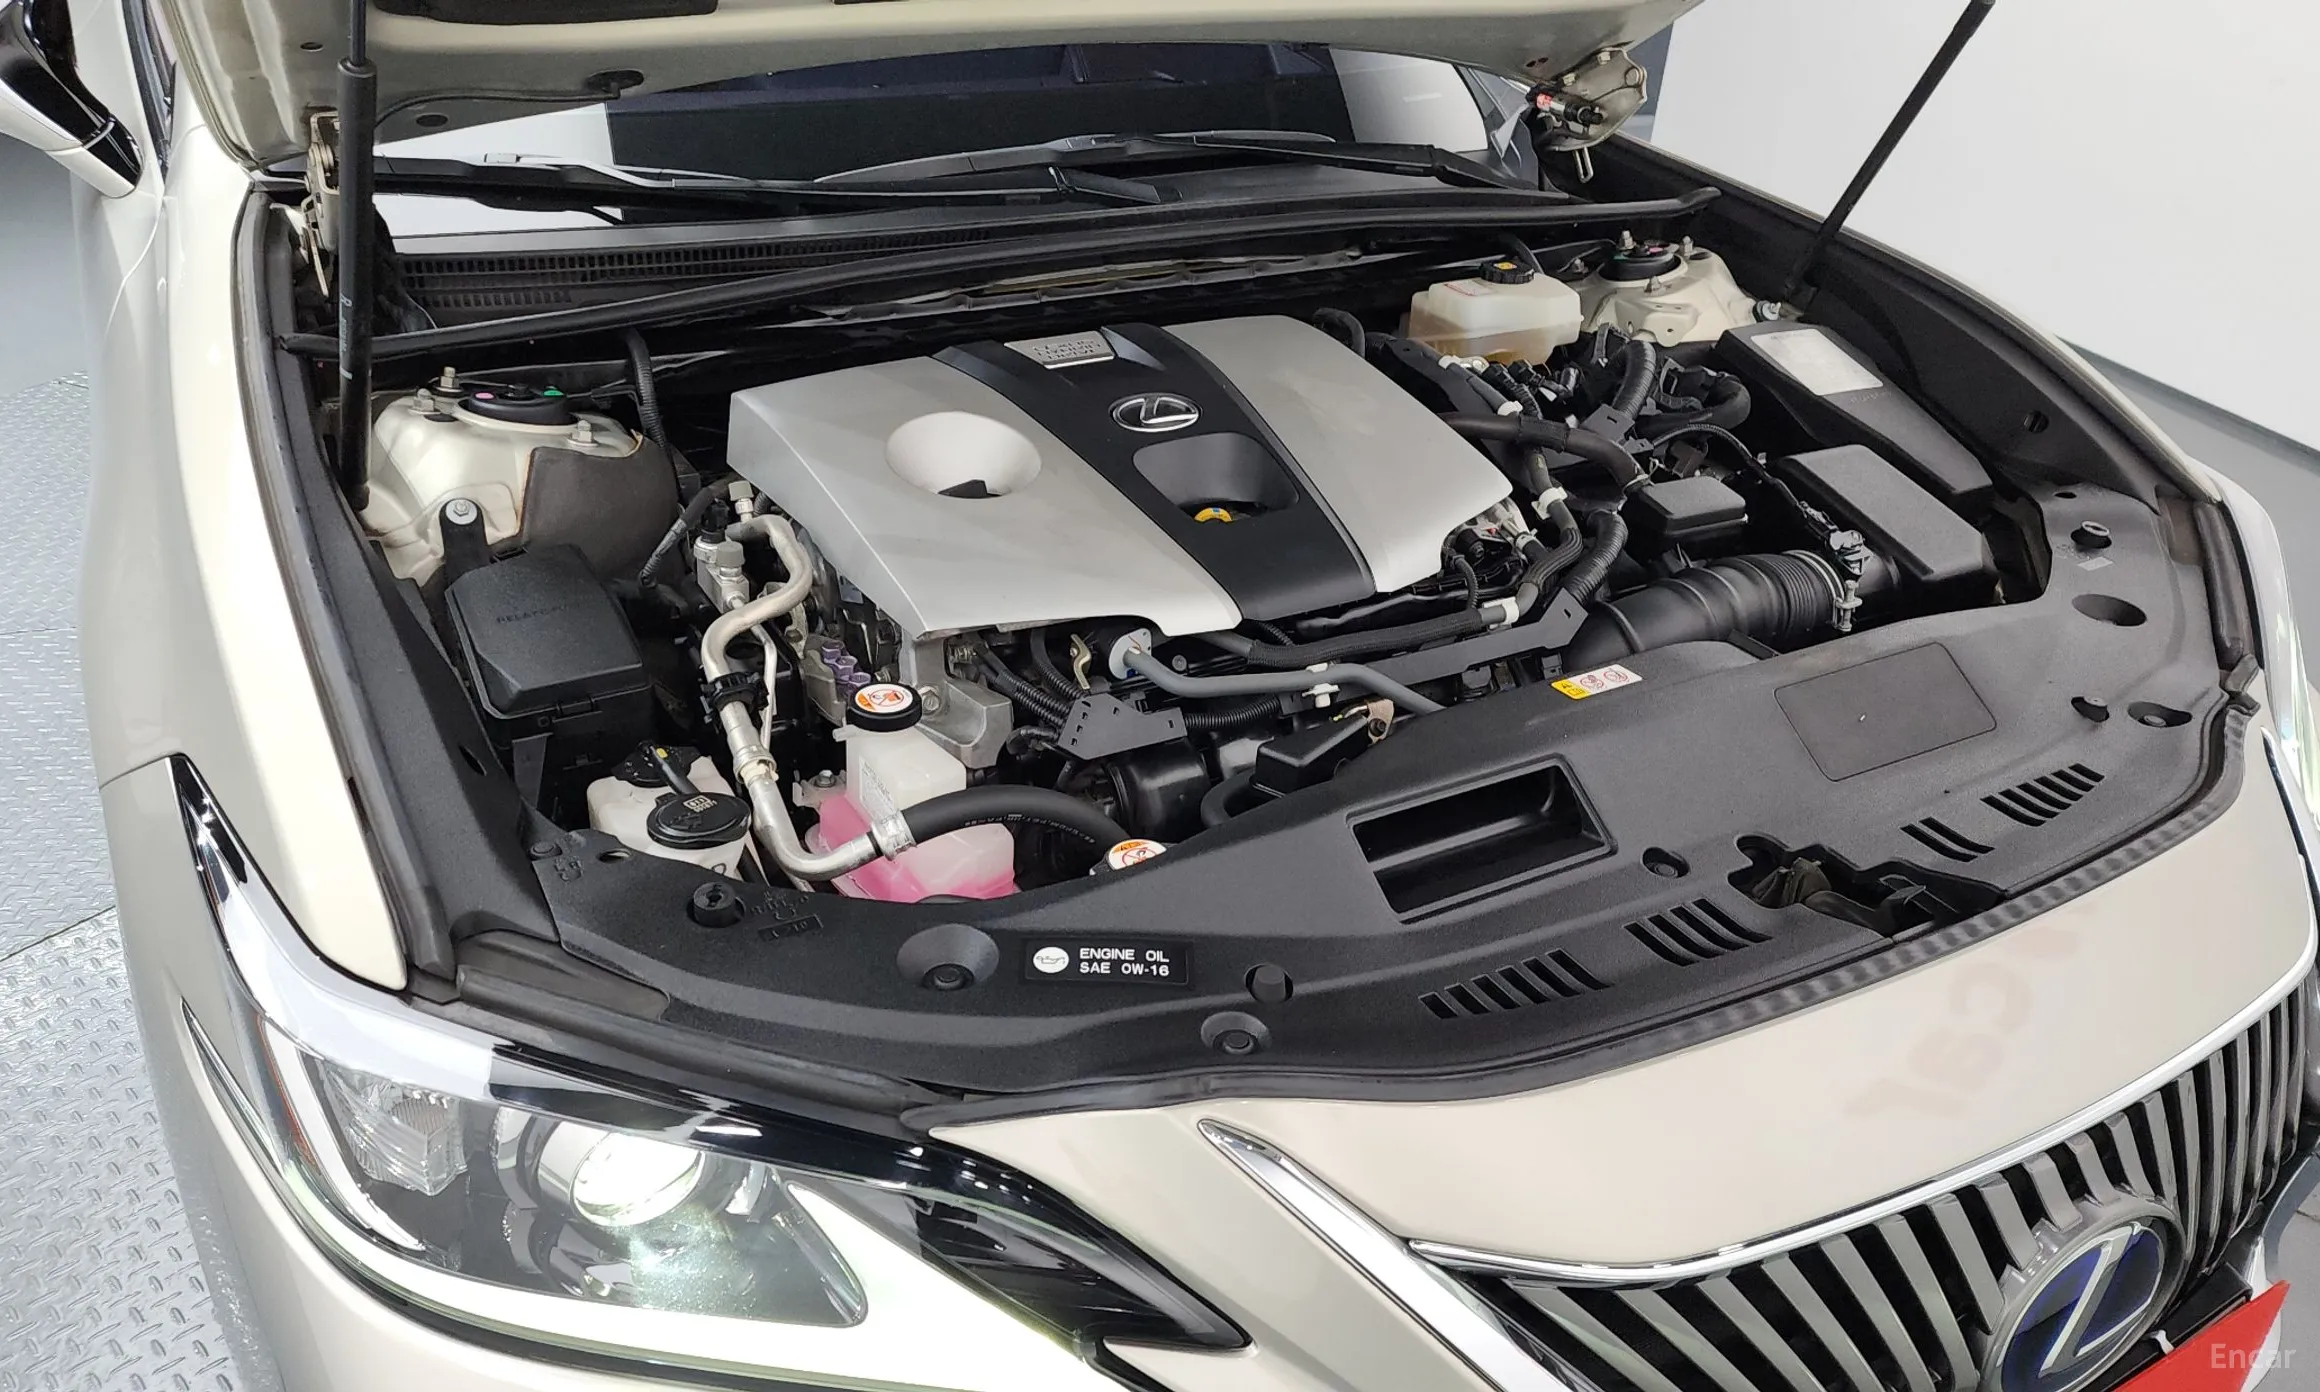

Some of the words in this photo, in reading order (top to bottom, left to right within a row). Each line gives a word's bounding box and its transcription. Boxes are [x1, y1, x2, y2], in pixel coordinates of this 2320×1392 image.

[1079, 947, 1136, 961] ENGINE
[1145, 950, 1170, 963] OIL
[1079, 961, 1111, 974] SAE
